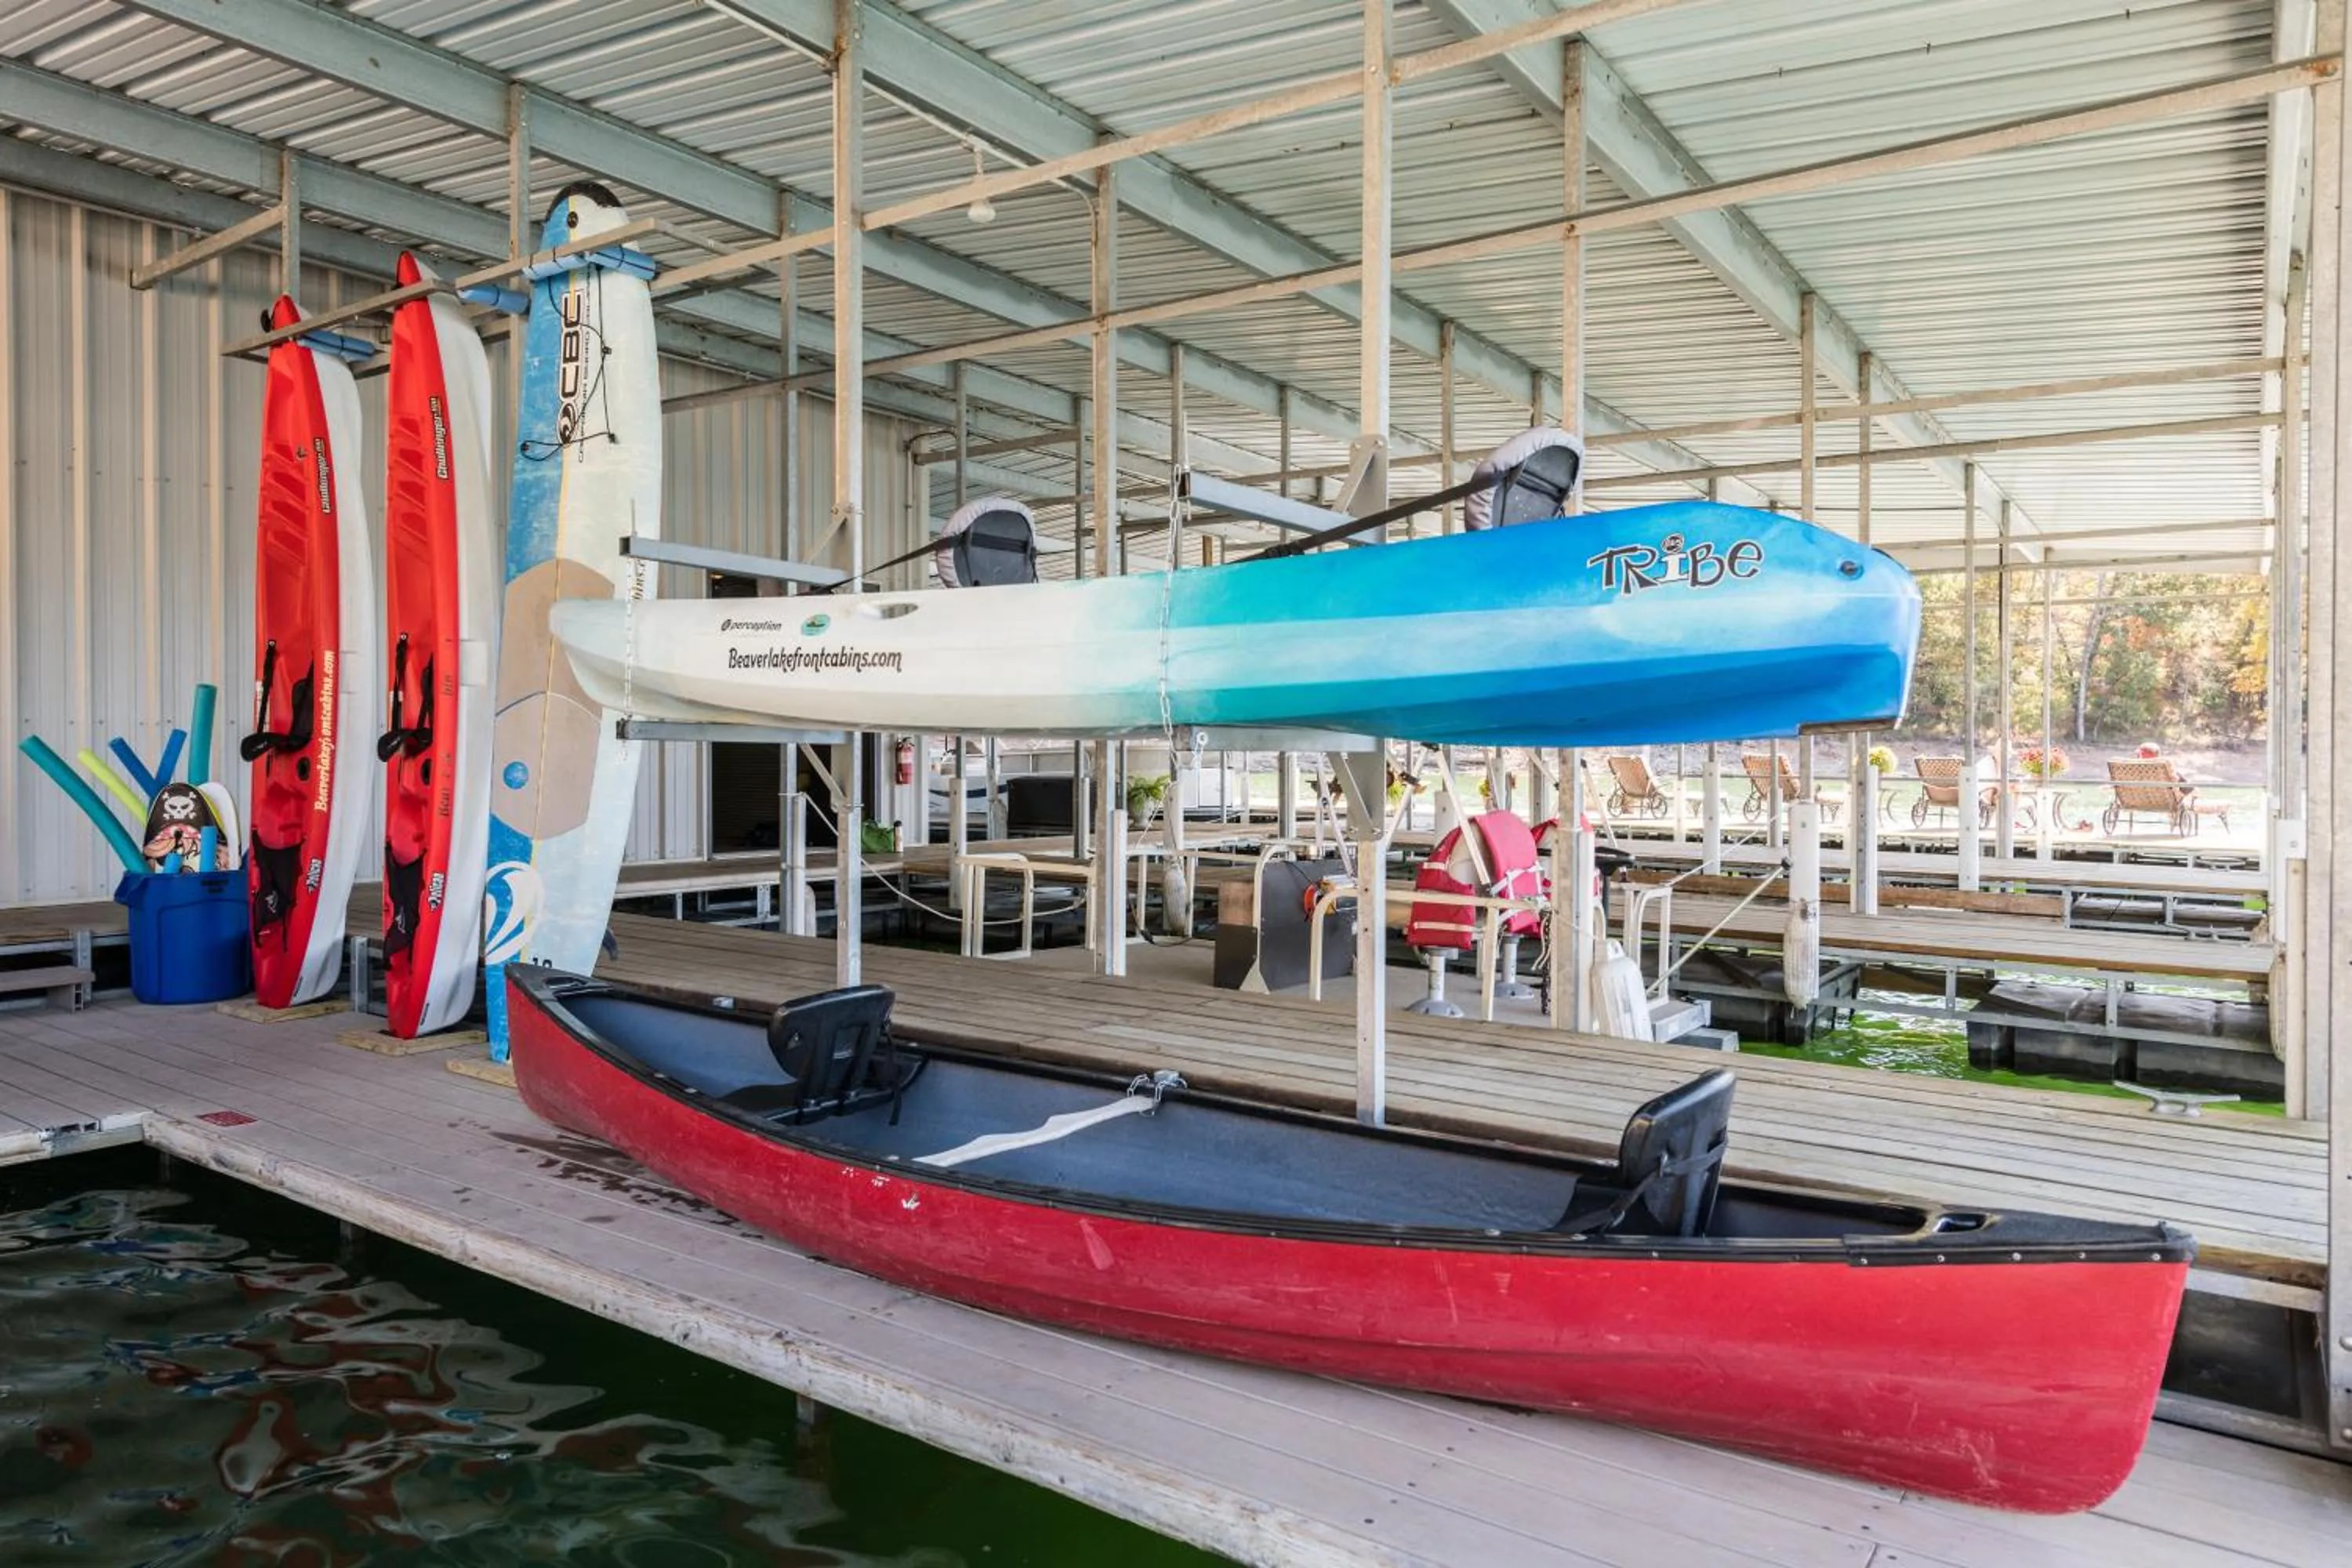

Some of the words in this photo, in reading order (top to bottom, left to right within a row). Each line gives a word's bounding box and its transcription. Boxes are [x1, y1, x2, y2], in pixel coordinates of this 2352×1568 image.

[561, 295, 581, 398] CBC
[730, 620, 782, 631] perception
[728, 646, 902, 673] Beaverlakefrontcabins.com
